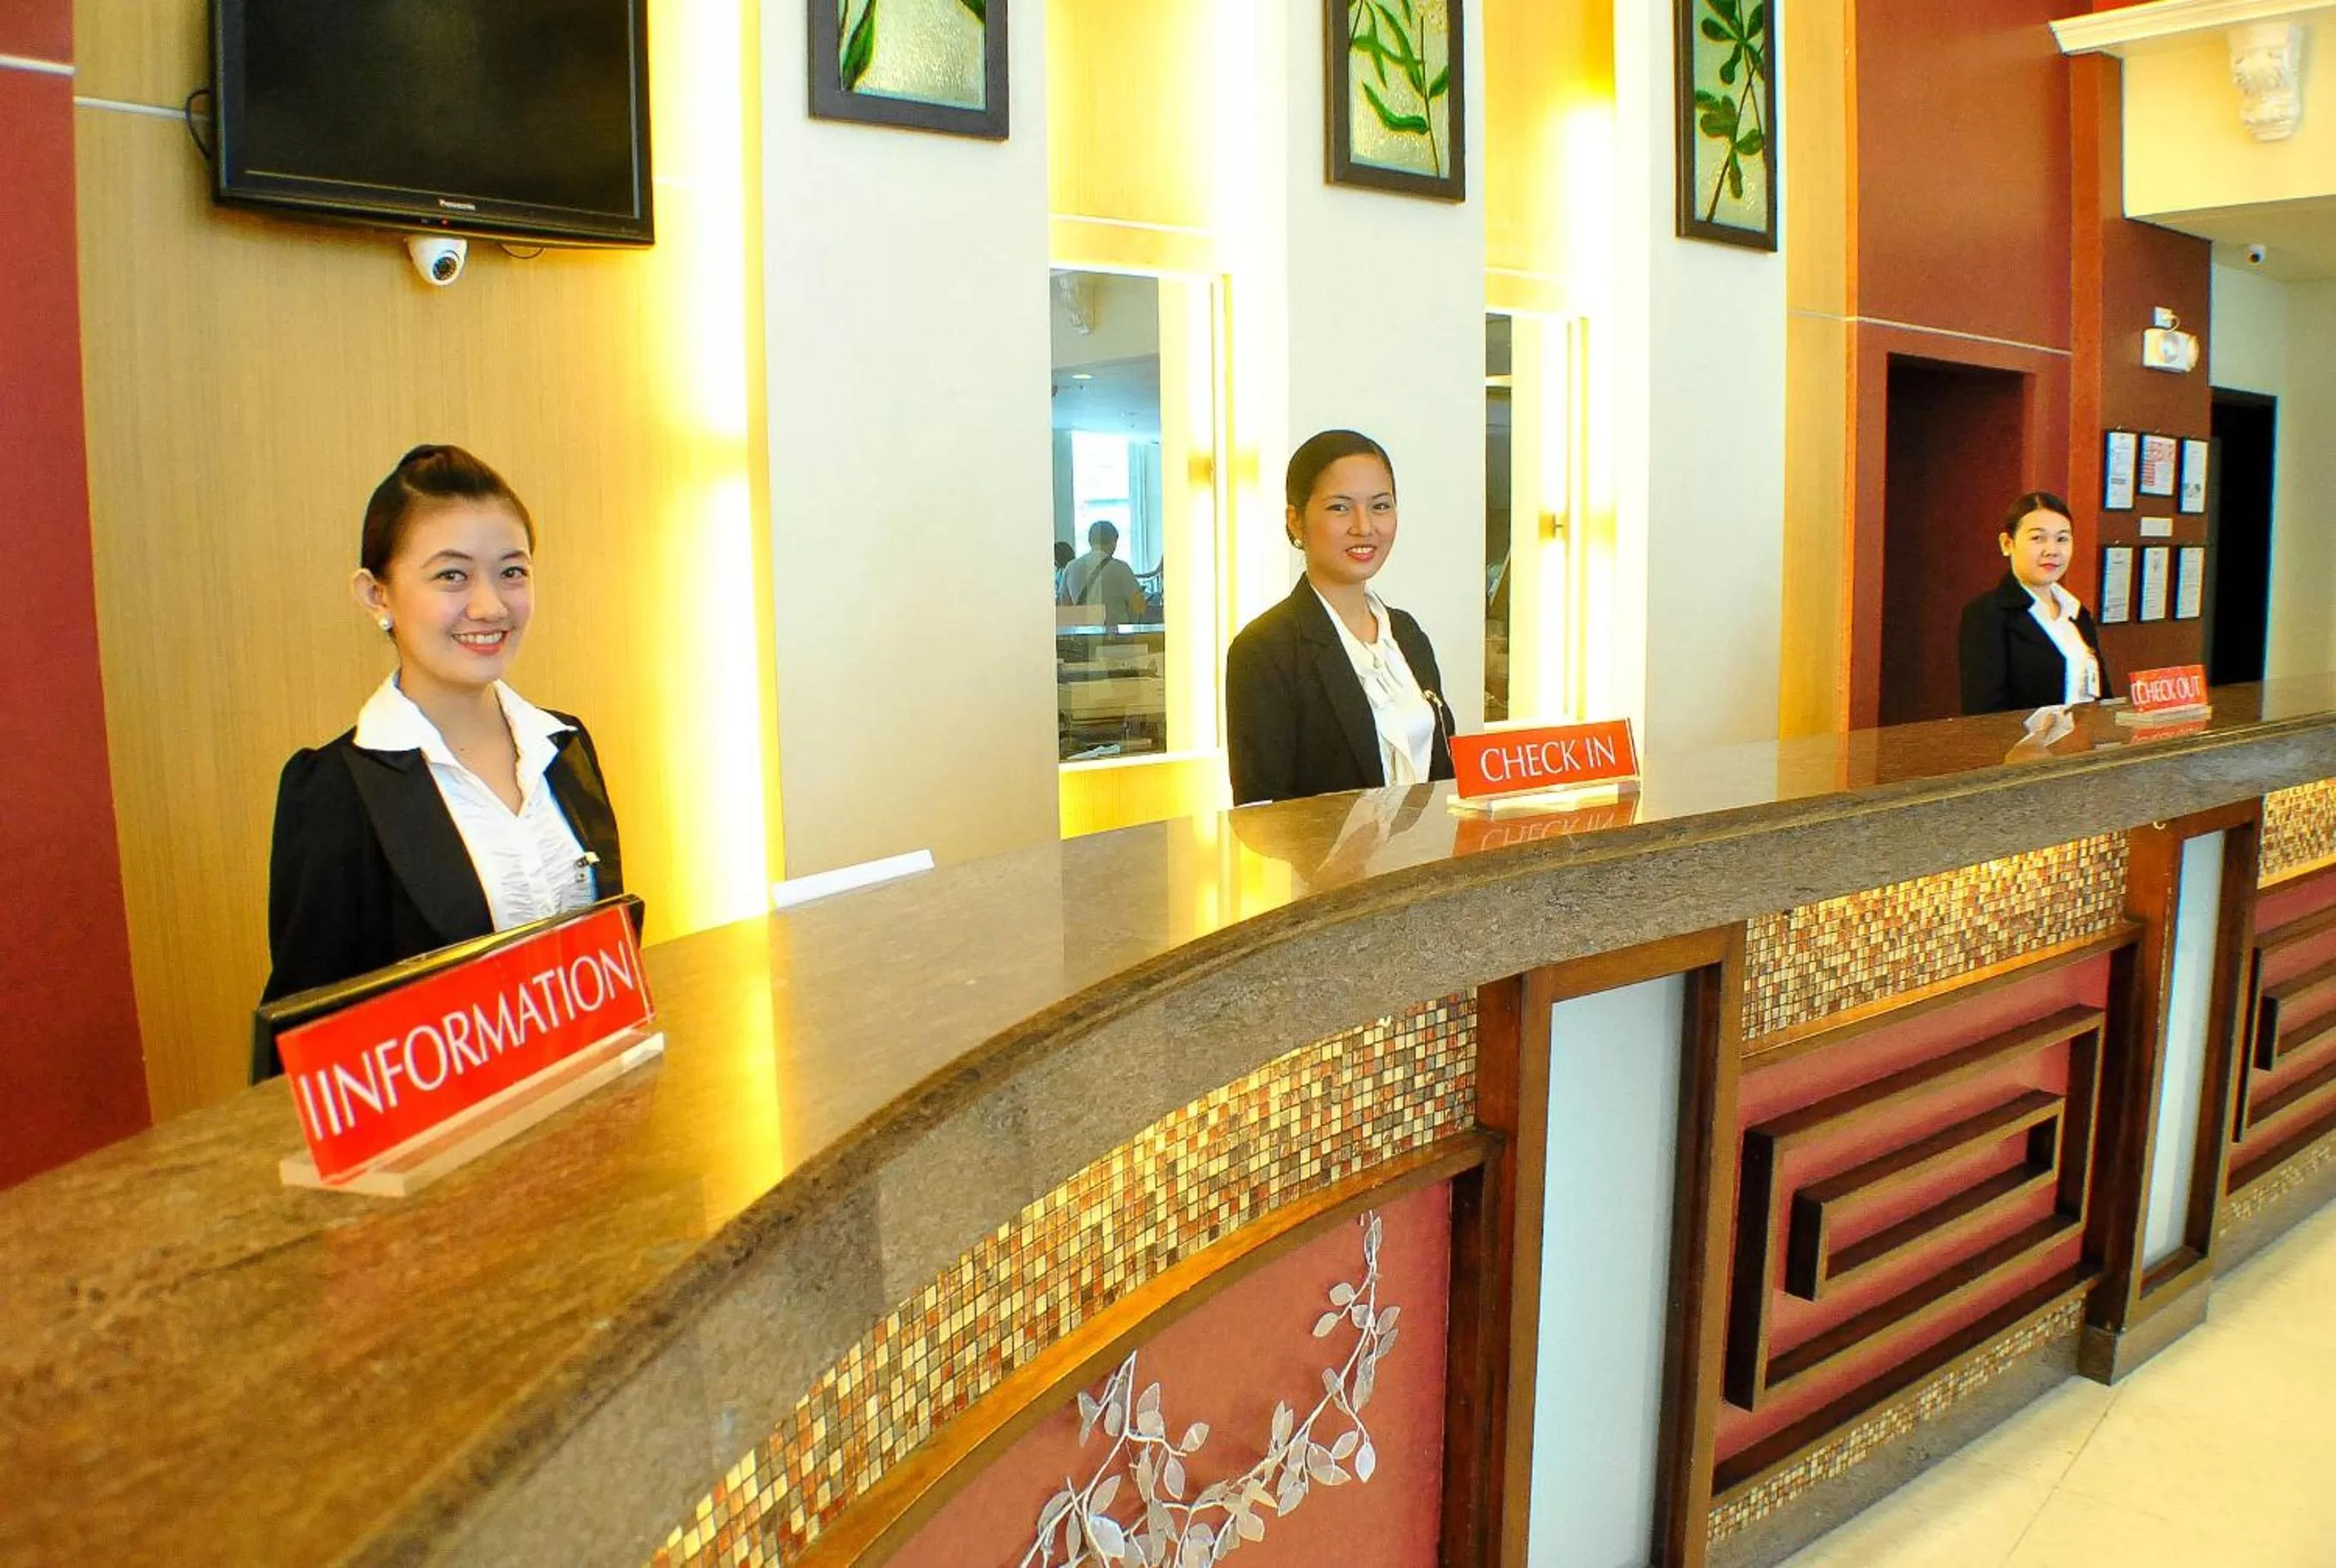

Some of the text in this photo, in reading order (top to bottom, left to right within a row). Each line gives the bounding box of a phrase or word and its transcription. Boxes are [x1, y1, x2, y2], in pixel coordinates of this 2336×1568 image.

[2176, 675, 2201, 699] OUT
[1480, 735, 1617, 782] CHECK IN
